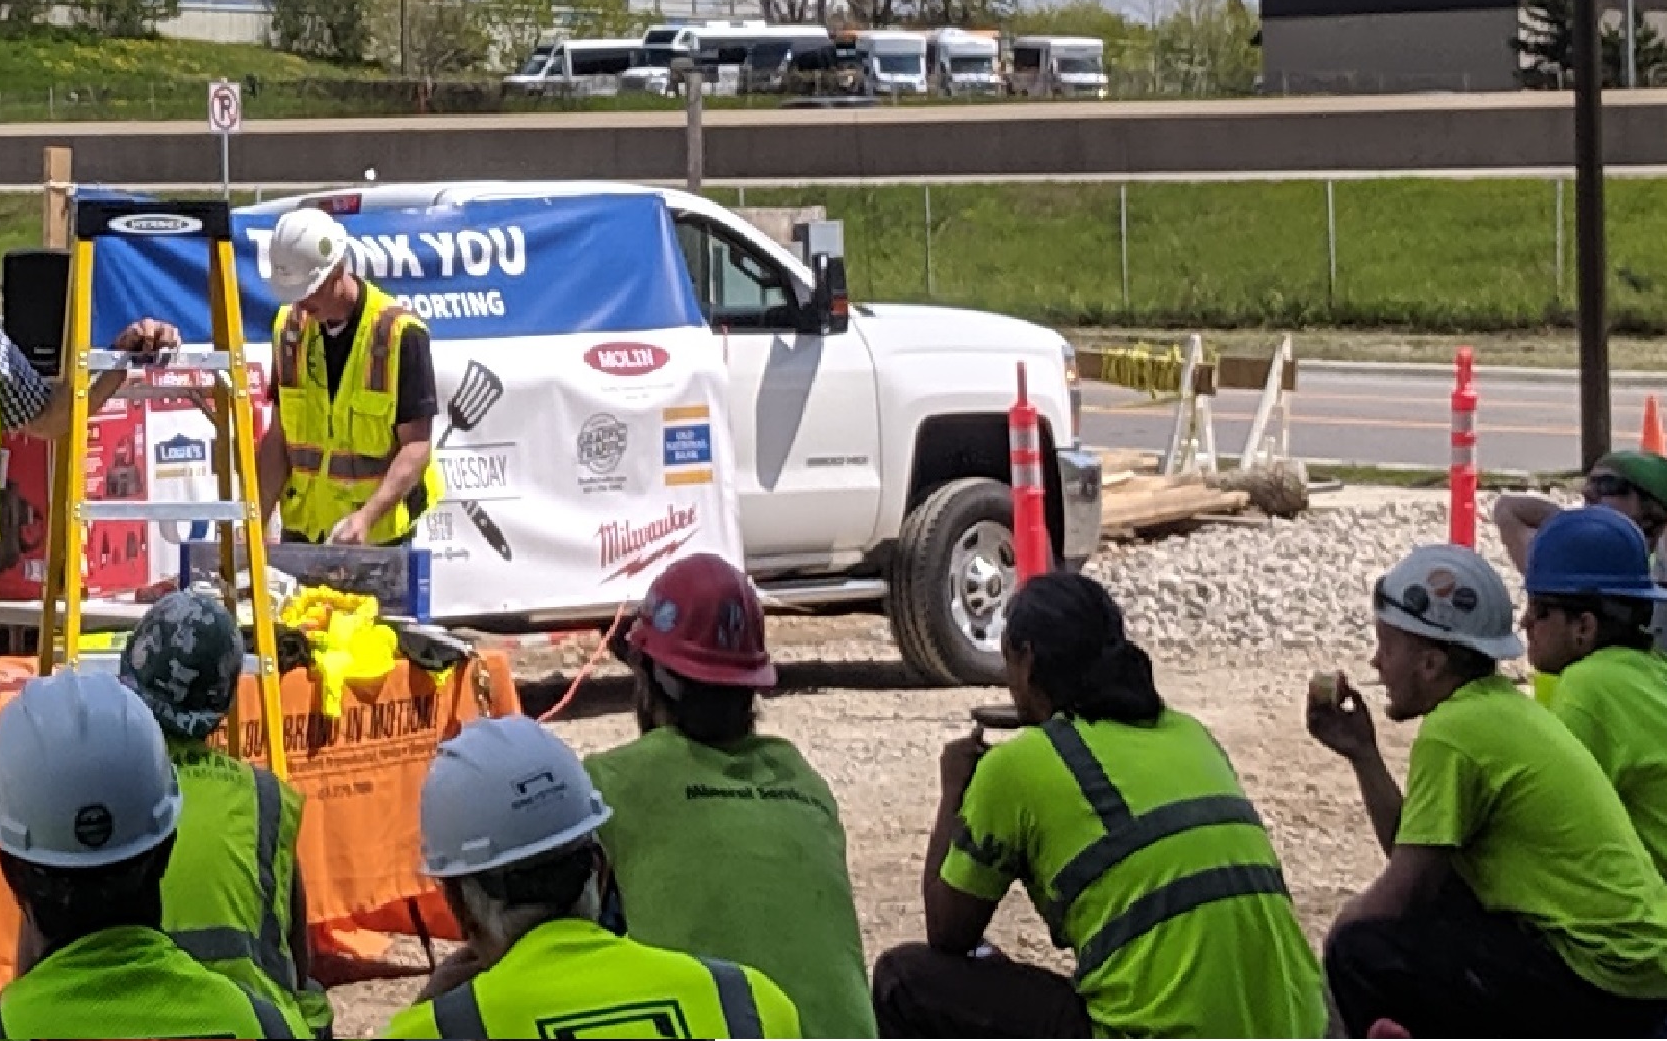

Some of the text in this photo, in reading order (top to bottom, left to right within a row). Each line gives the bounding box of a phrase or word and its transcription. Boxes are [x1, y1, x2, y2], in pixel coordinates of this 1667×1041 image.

[246, 226, 526, 278] TNK YOU
[402, 289, 505, 320] PORTING
[598, 349, 654, 368] MOLIN
[594, 503, 698, 569] Milwaukee
